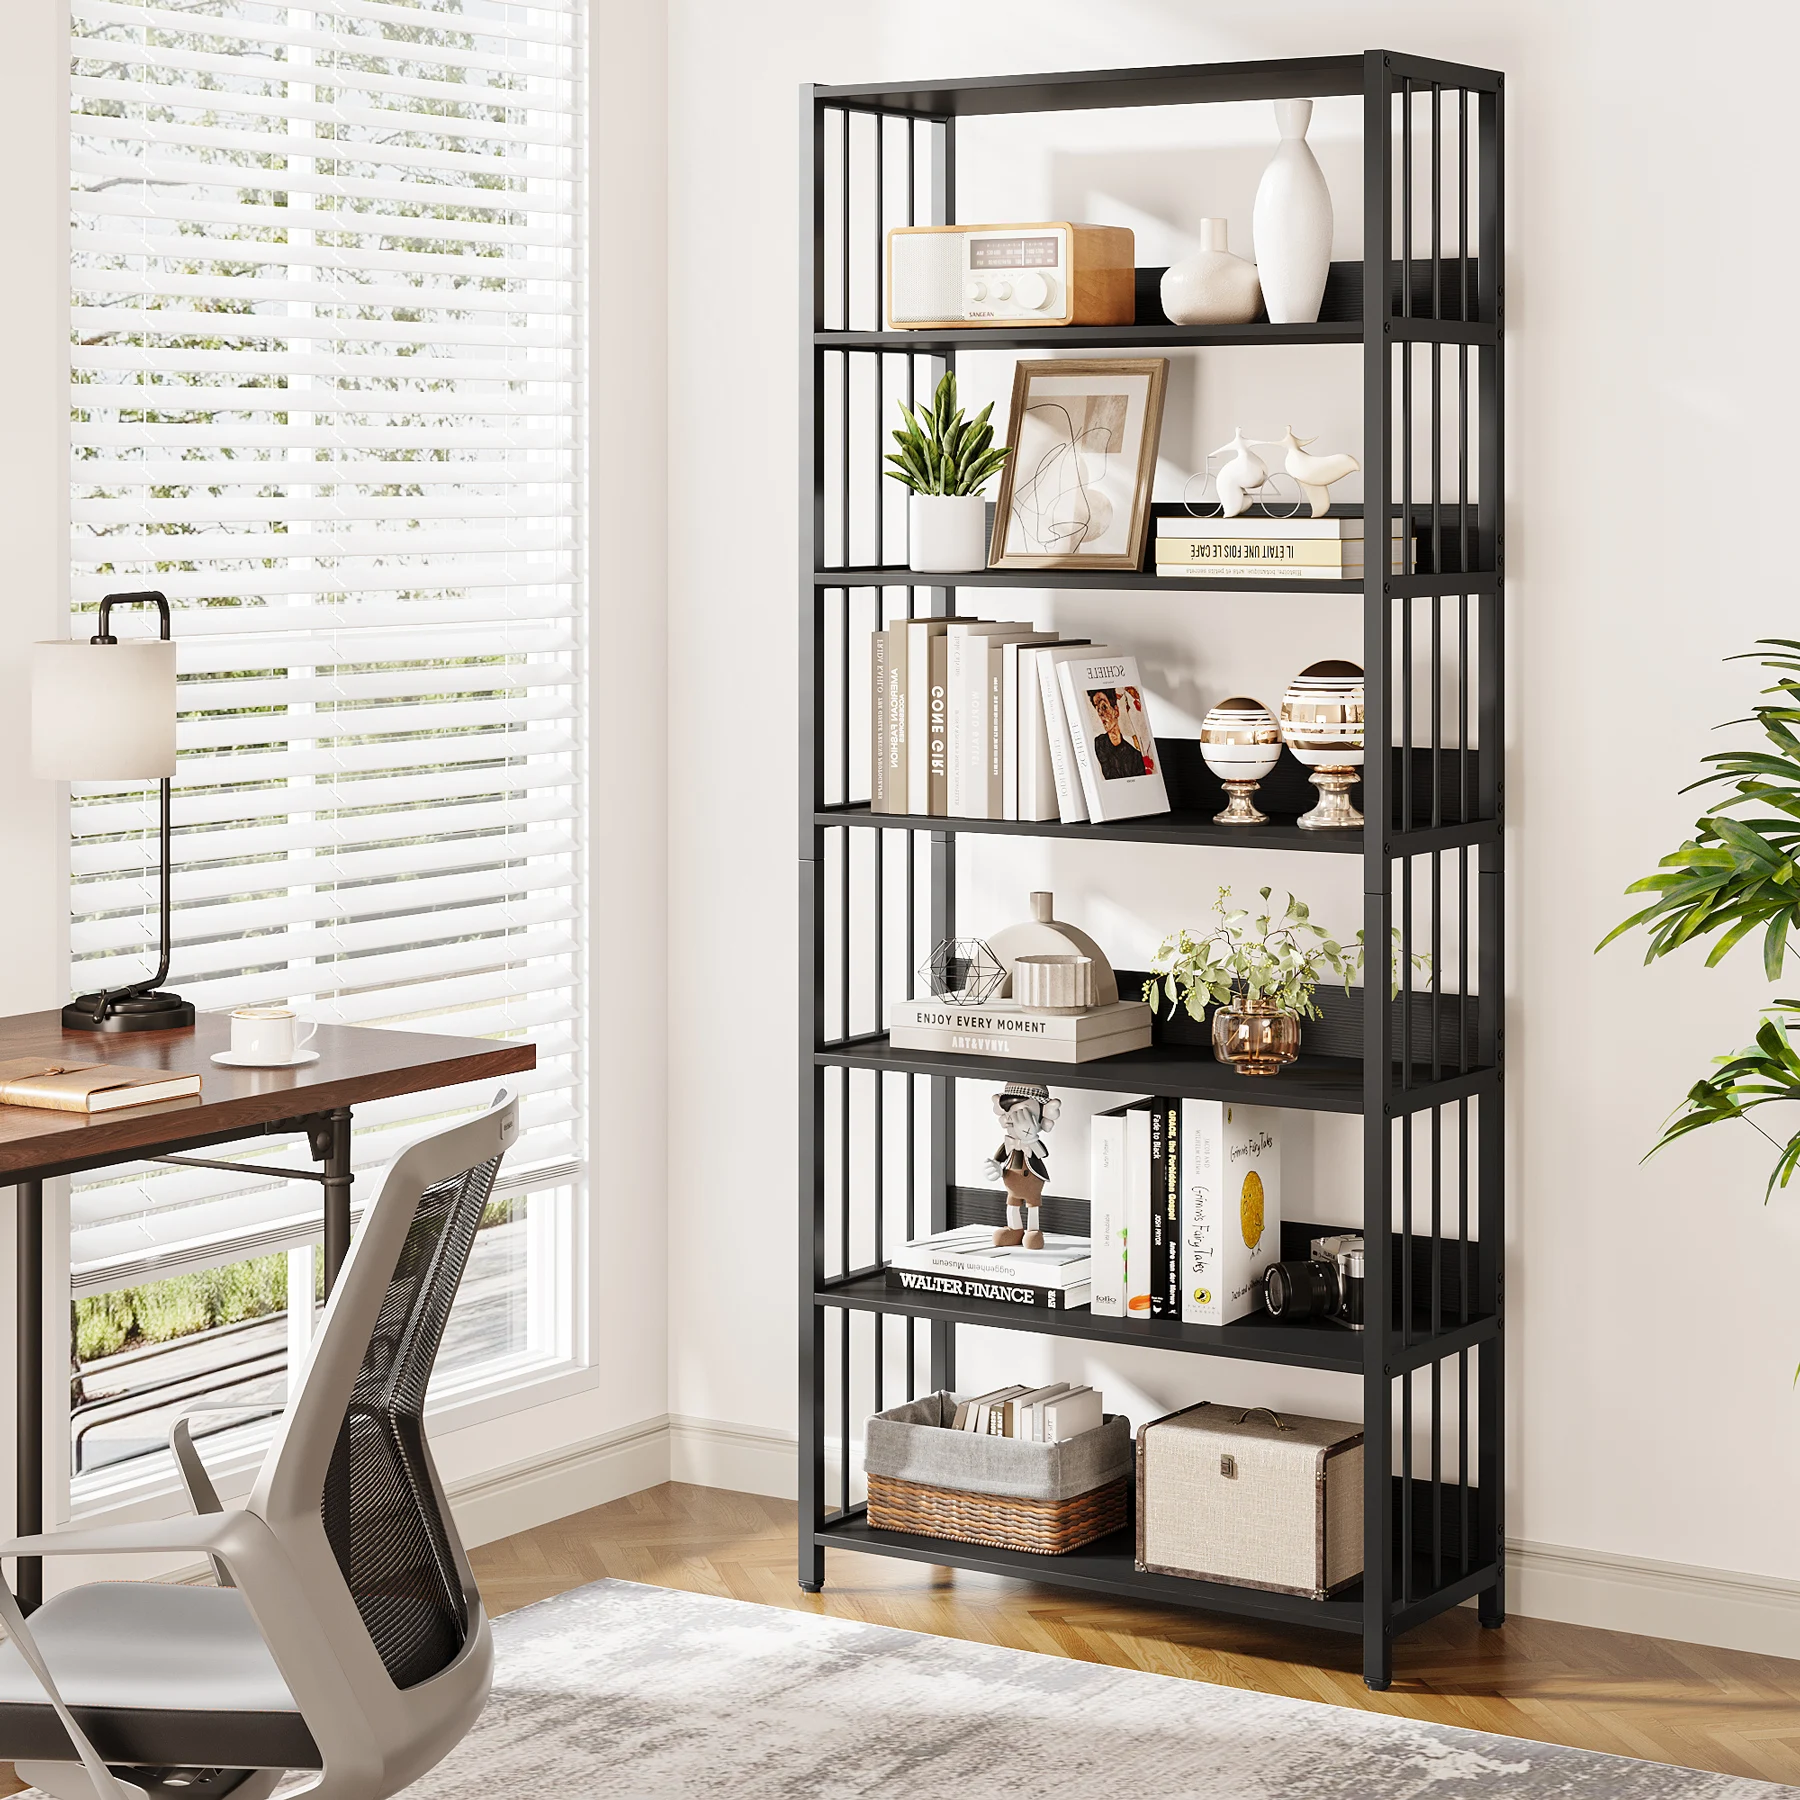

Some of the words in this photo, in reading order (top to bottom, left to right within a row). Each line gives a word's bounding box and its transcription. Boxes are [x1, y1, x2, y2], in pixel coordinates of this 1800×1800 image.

[1190, 544, 1211, 560] CAFÉ
[1213, 544, 1222, 558] LE
[1224, 545, 1242, 558] FOIS
[1244, 545, 1260, 558] UNE
[1262, 545, 1284, 561] ÉTAIT
[1287, 545, 1294, 559] IL
[917, 1012, 952, 1026] ENJOY
[957, 1015, 992, 1029] EVERY
[997, 1019, 1046, 1034] MOMENT
[1153, 1114, 1162, 1131] Fade
[1168, 1110, 1177, 1139] GRACE,
[1153, 1132, 1161, 1140] to
[1153, 1141, 1162, 1159] Black
[1168, 1140, 1177, 1153] the
[1168, 1154, 1177, 1192] Forbidden
[1168, 1193, 1177, 1221] Gospel
[932, 1258, 965, 1270] Museum
[966, 1263, 1016, 1277] Guggenheim
[899, 1272, 963, 1294] WALTER
[964, 1281, 1035, 1304] FINANCE
[1047, 1290, 1057, 1308] EVR
